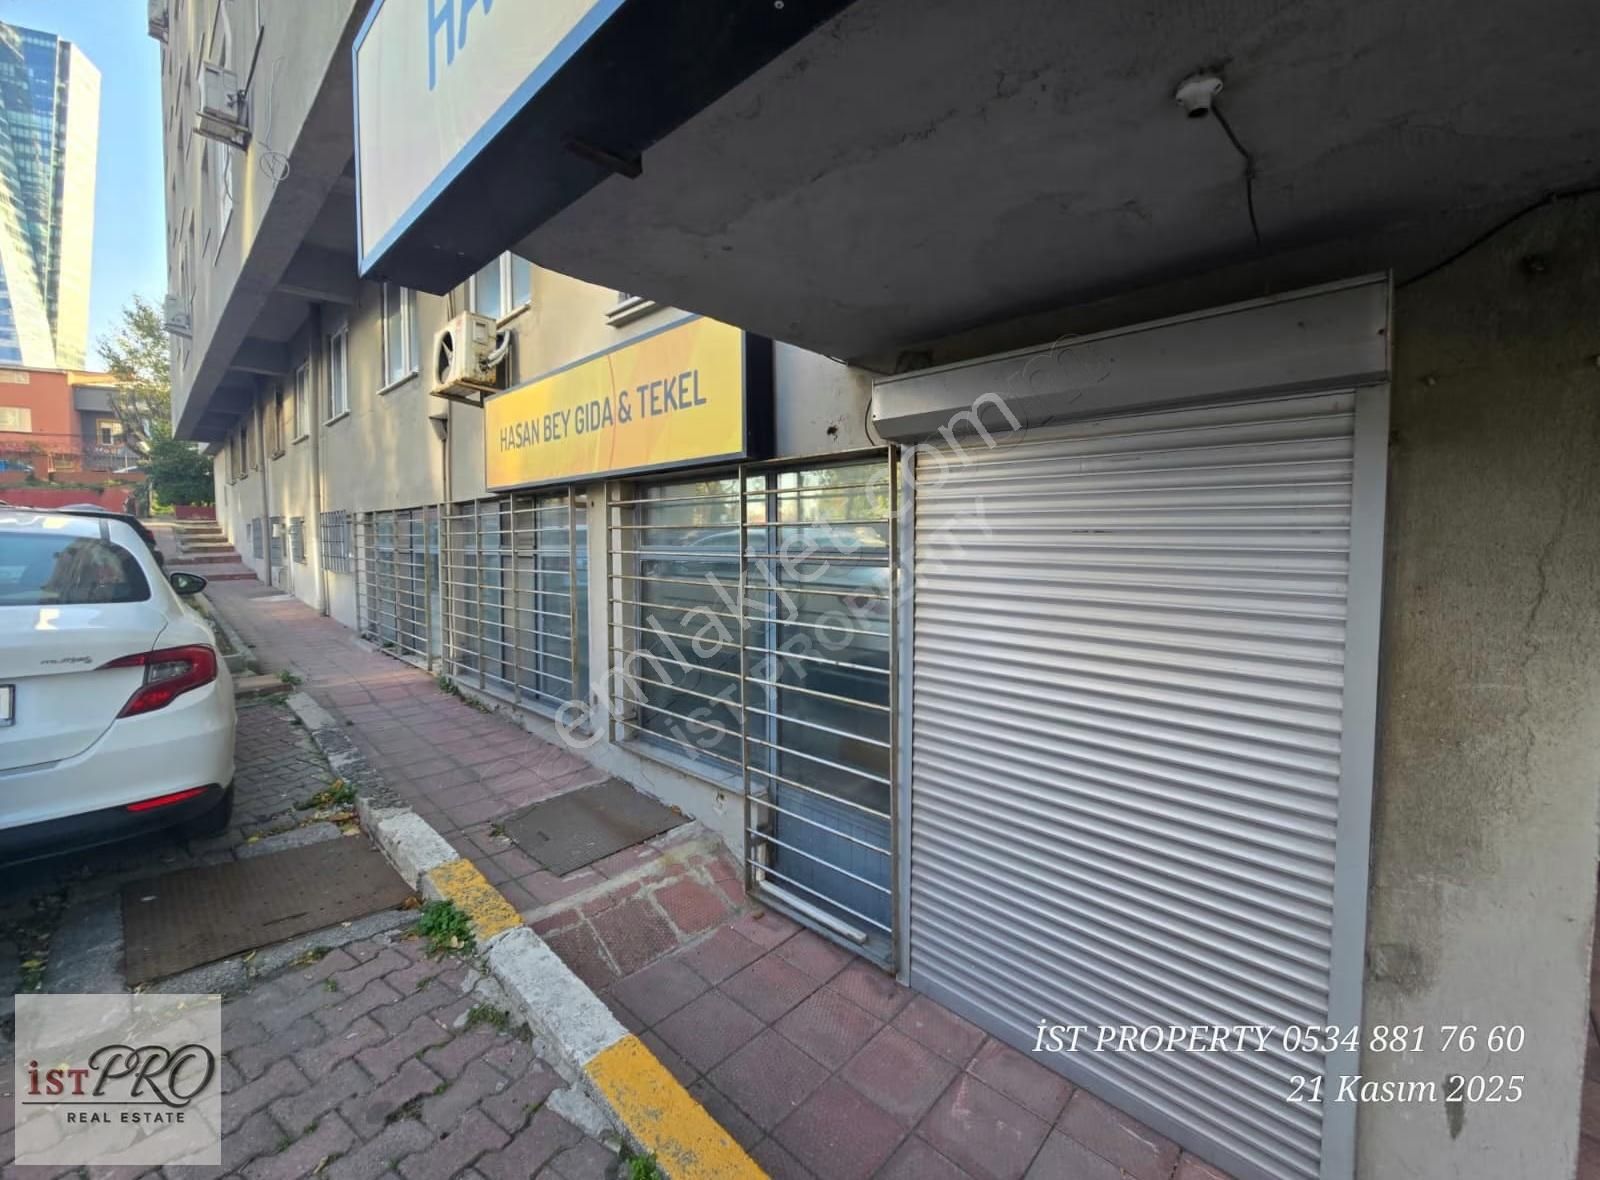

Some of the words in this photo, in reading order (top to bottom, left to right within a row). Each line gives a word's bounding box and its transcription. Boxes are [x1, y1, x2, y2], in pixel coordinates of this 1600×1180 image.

[500, 419, 540, 452] HASAN
[543, 409, 571, 442] BEY
[575, 397, 613, 434] GIDA
[618, 390, 632, 424] &
[636, 369, 707, 418] TEKEL
